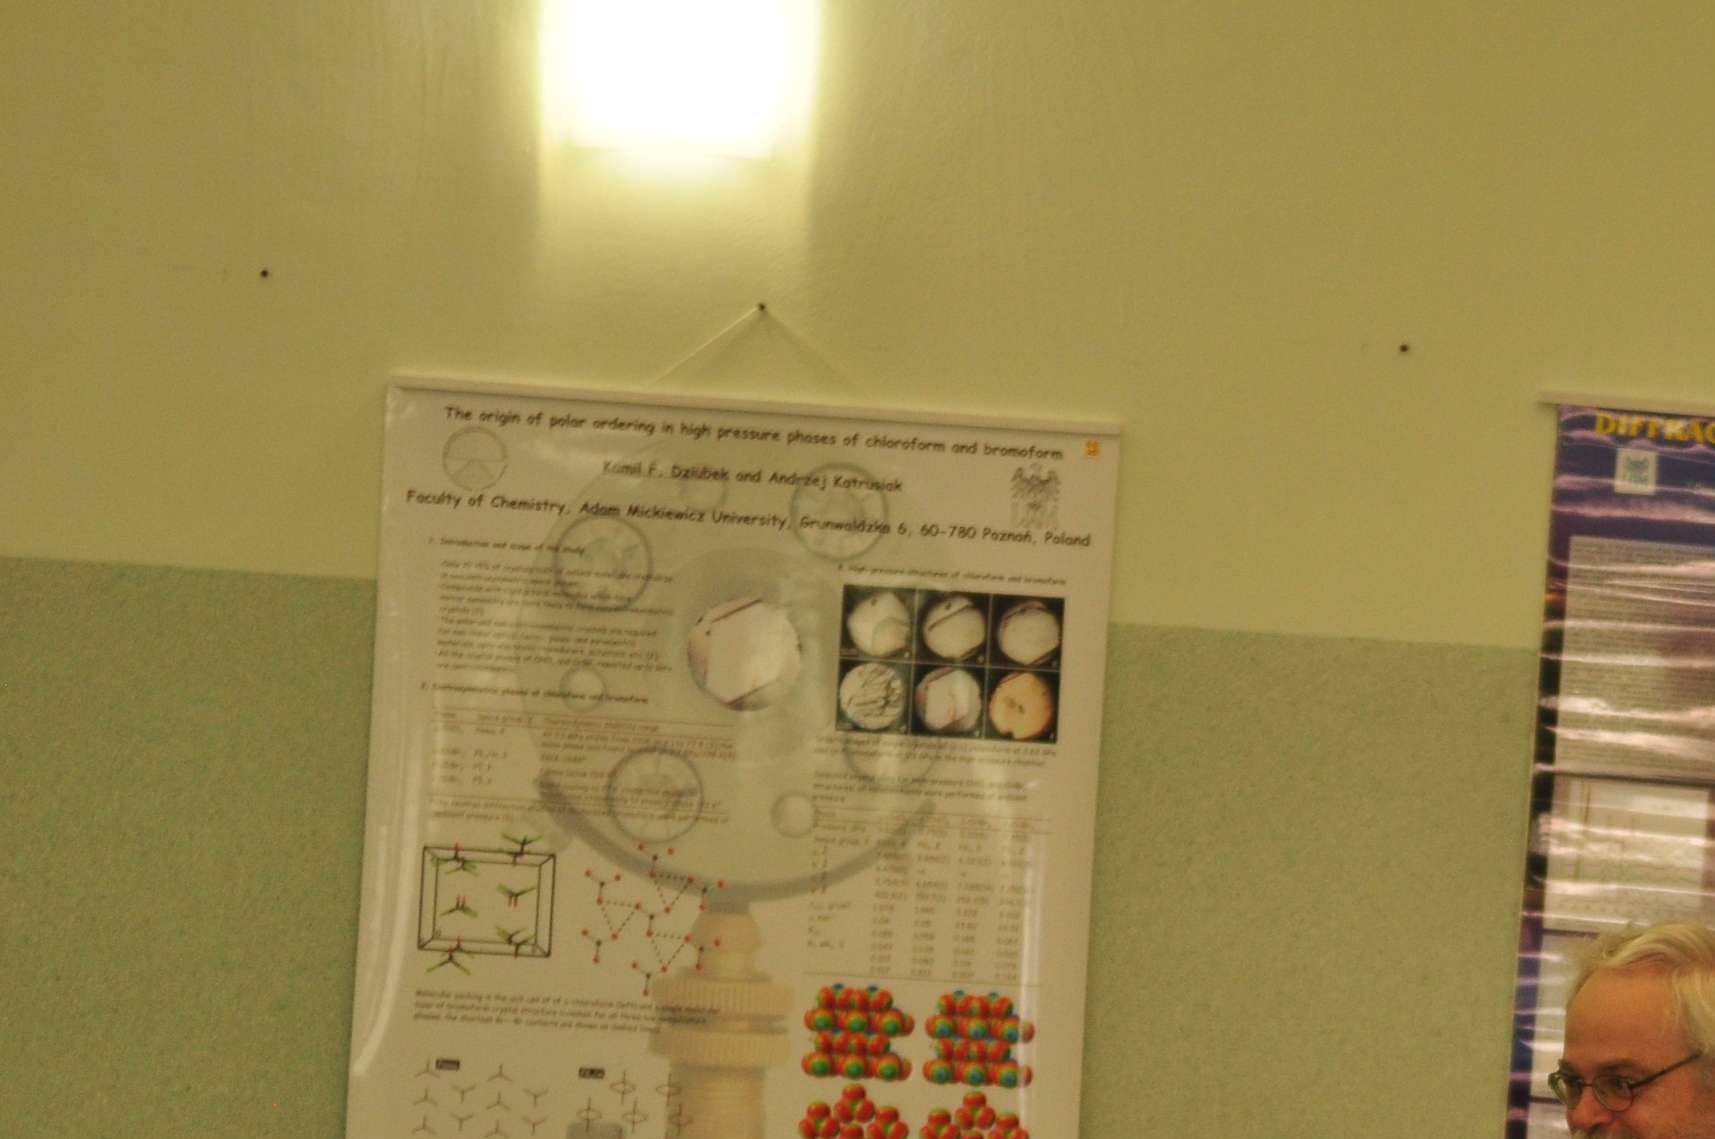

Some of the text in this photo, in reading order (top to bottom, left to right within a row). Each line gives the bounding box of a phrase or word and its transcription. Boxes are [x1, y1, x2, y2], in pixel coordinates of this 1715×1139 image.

[445, 406, 1064, 461] The origin of polar ordering in high pressure phases of chloroform and bromoform
[602, 460, 903, 493] Kamil F. Dziubek and Andrzej Katrusiak
[407, 489, 462, 509] Faculty
[467, 492, 485, 507] of
[491, 495, 571, 517] Chemistry,
[580, 502, 621, 517] Adam
[627, 505, 705, 523] Mickiewicz
[712, 511, 792, 531] University,
[799, 515, 891, 535] Grunwaldzka
[920, 523, 977, 540] 60-780
[1045, 529, 1092, 548] Poland
